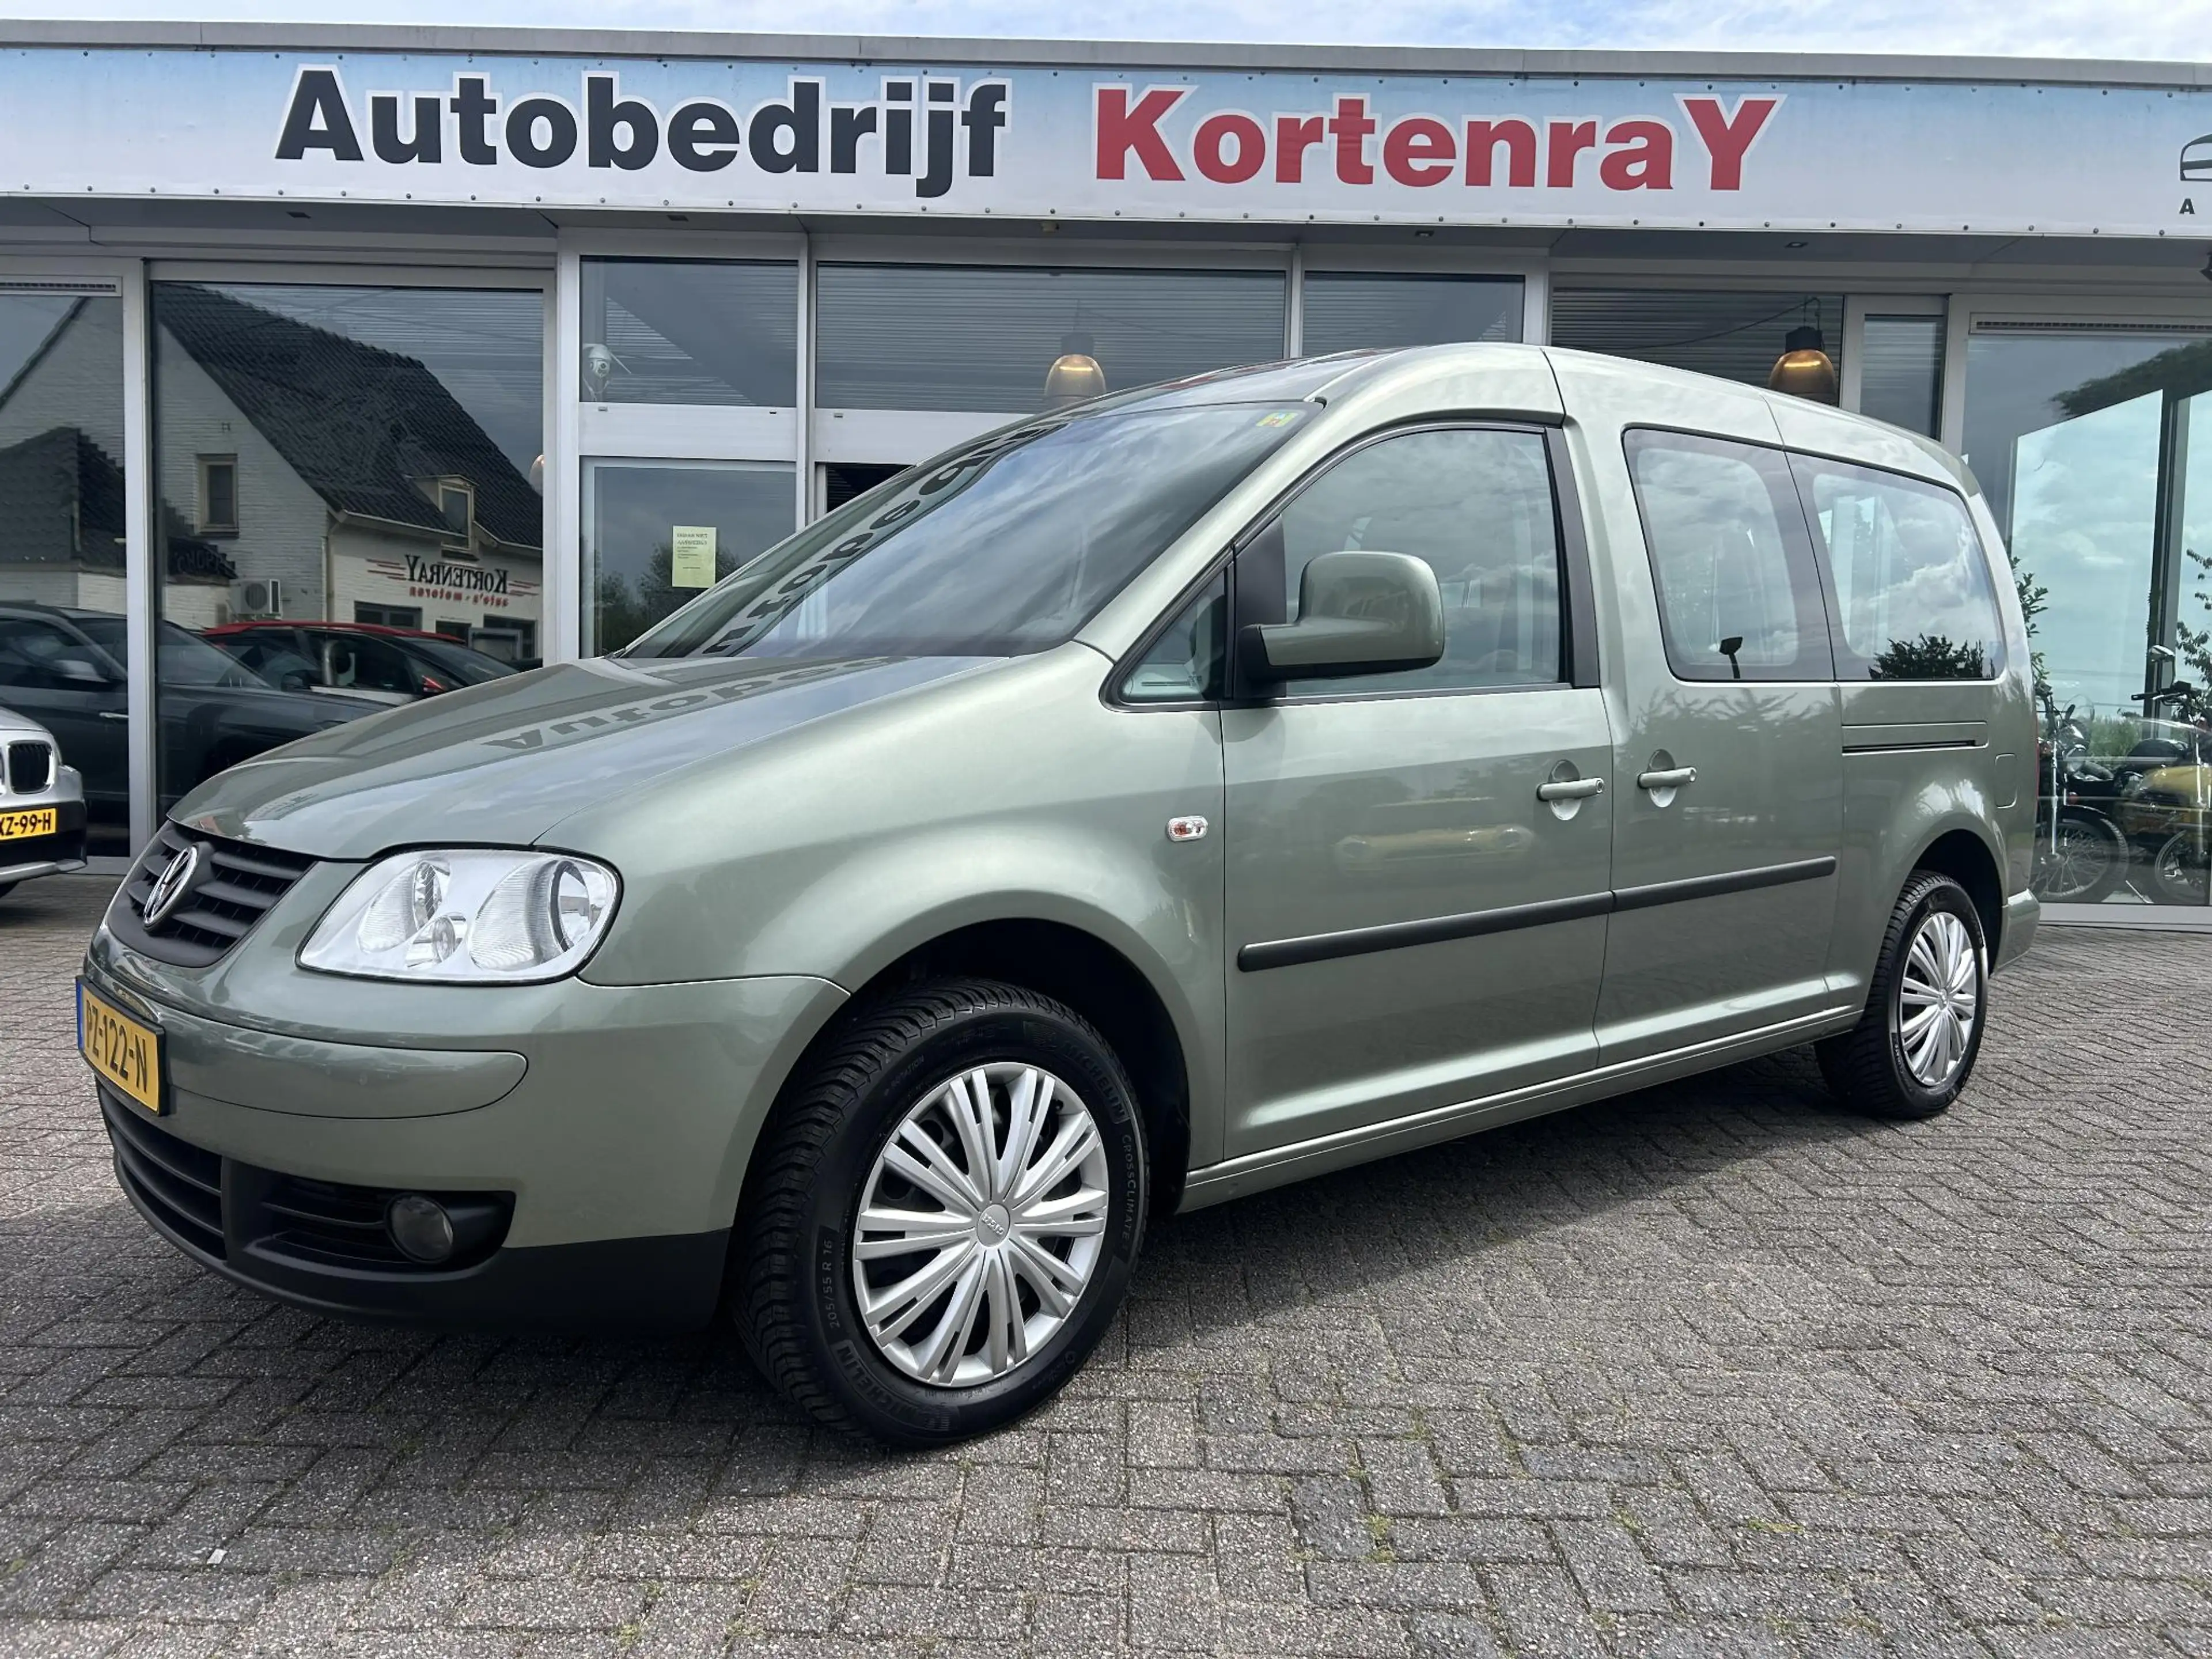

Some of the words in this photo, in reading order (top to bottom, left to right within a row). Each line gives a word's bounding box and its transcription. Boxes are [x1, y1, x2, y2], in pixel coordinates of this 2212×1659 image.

[275, 69, 1006, 198] Autobedrijf
[86, 998, 147, 1094] PZ-122-N
[821, 1262, 832, 1271] R
[823, 1238, 833, 1255] 16
[821, 1276, 840, 1330] 205/55
